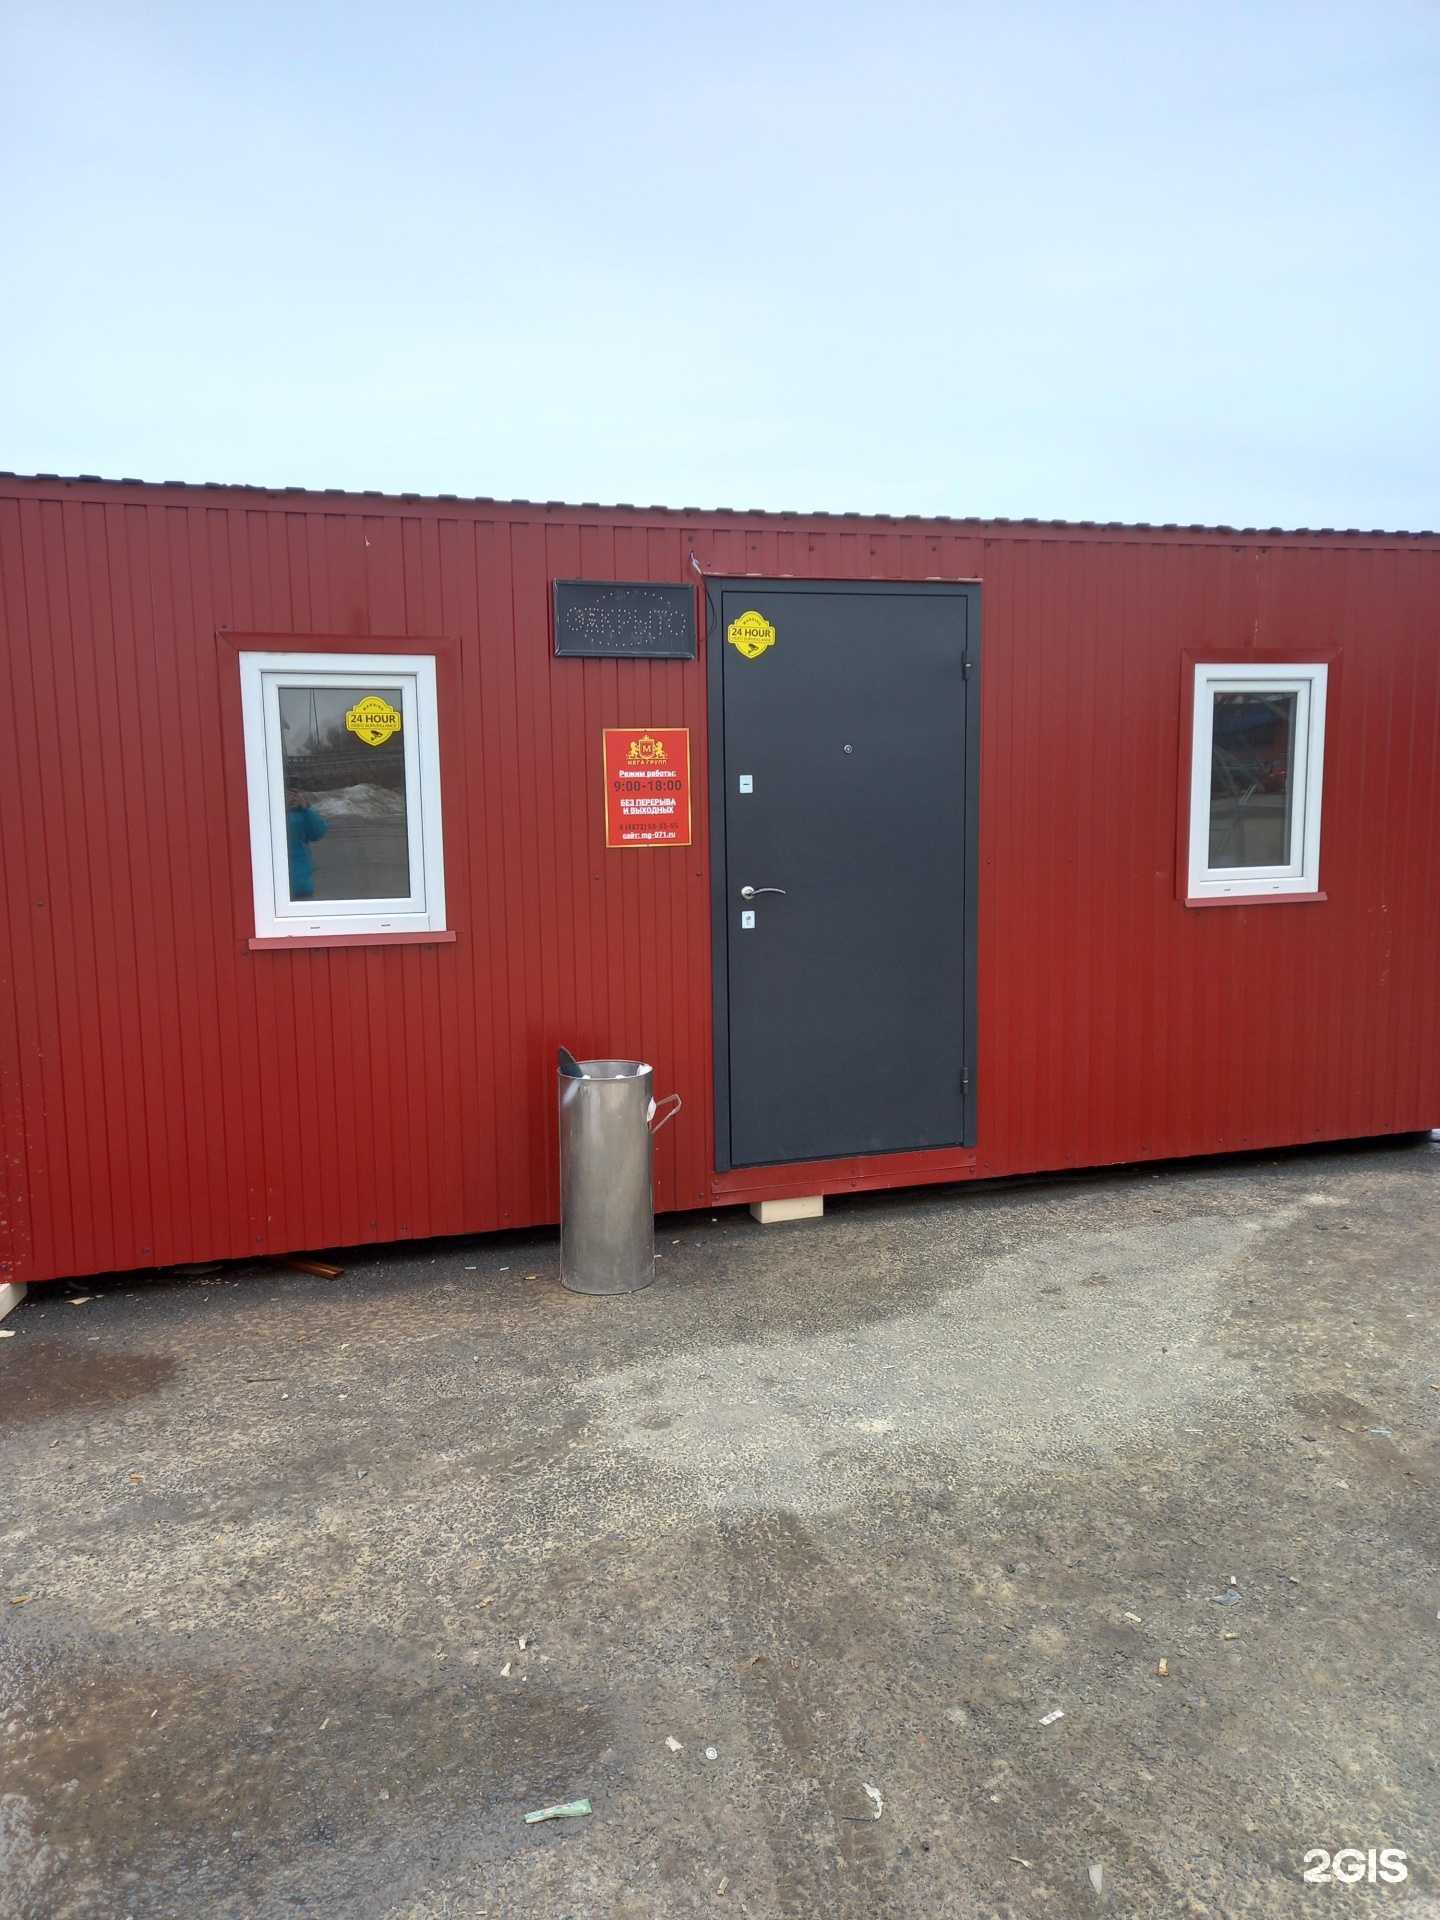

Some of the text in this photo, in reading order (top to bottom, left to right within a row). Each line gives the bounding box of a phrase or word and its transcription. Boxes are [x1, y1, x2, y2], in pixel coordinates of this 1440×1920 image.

[731, 628, 771, 638] 24 HOUR
[351, 714, 396, 724] 24 HOUR
[618, 770, 646, 778] Режим
[620, 798, 677, 807] БЕЗ ПЕРЕРЫВА
[623, 806, 674, 815] И ВЫХОДНЫХ
